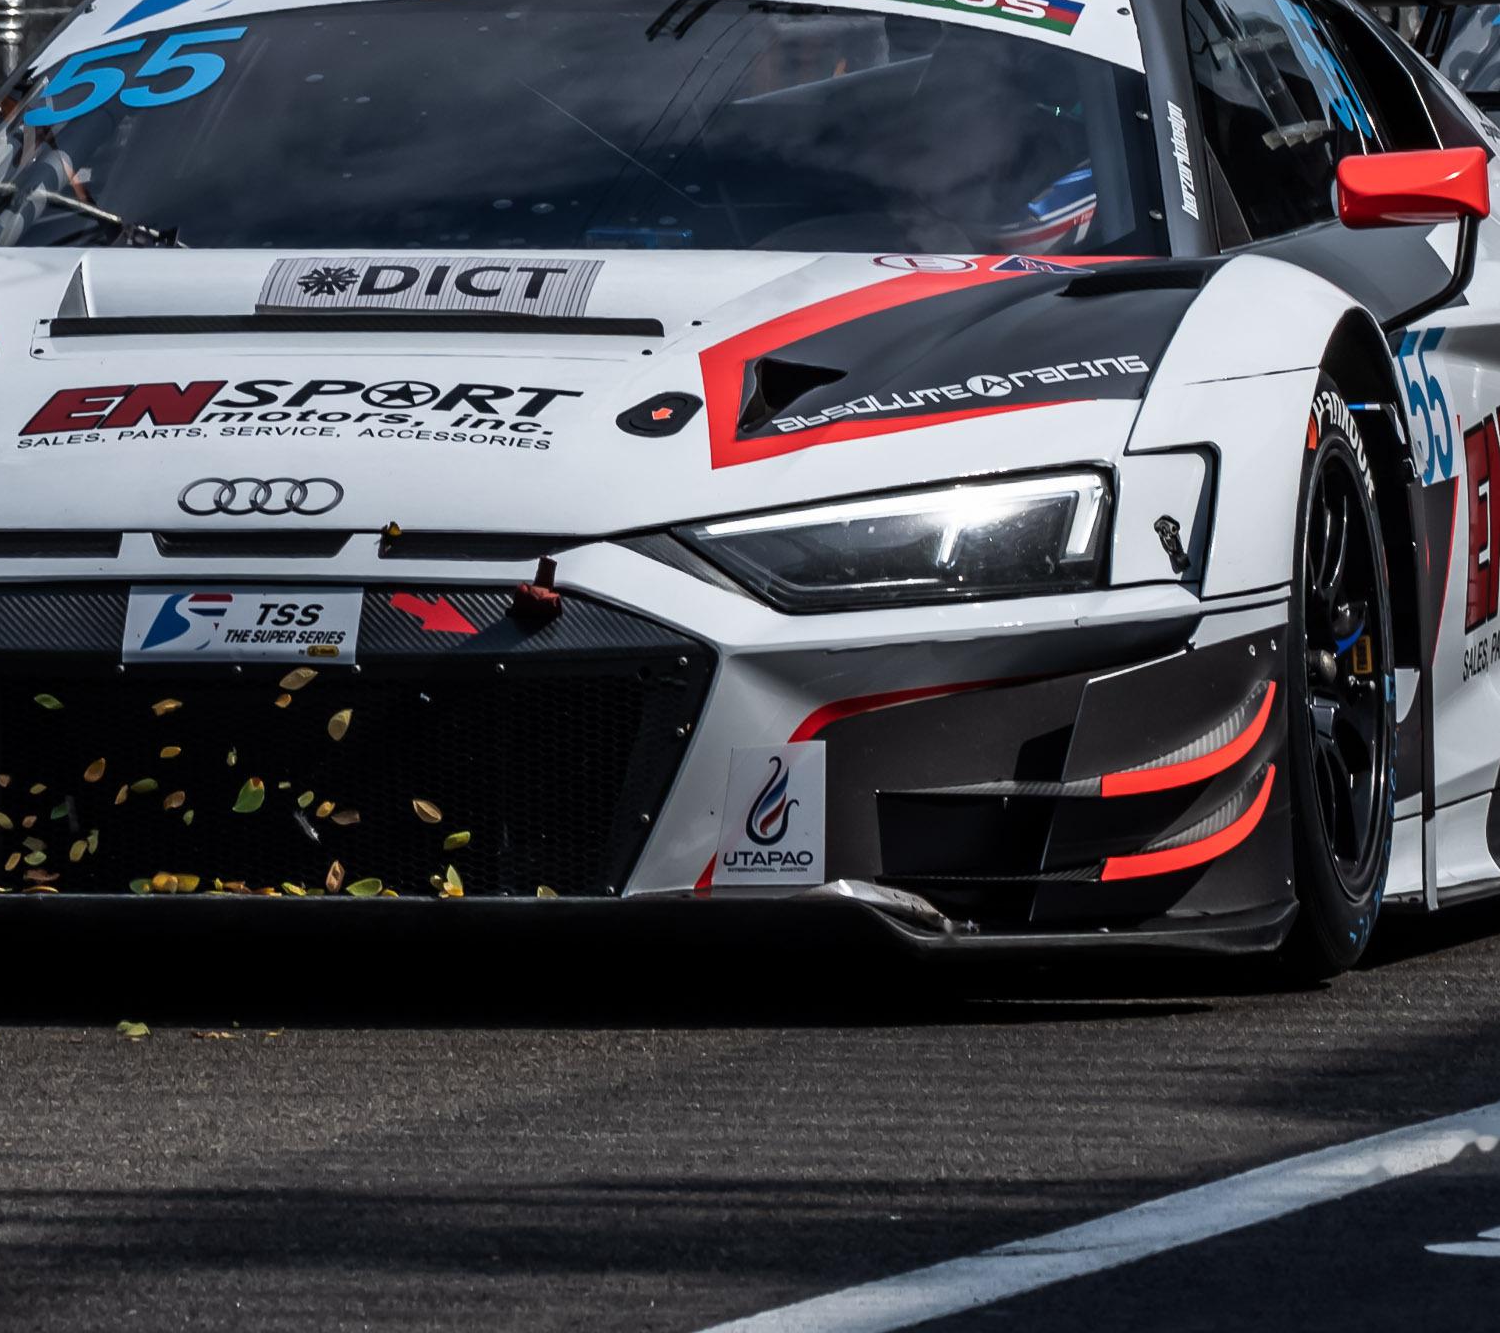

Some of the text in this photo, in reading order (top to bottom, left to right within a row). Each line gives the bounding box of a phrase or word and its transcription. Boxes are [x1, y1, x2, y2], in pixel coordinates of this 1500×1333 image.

[23, 26, 249, 127] 55
[357, 264, 569, 299] DICT
[201, 409, 555, 437] motors, inc.
[17, 425, 553, 452] SALES, PARTS, SERVICE, ACCESSORIES
[256, 603, 324, 627] TSS
[224, 629, 347, 644] THE SUPER SERIES
[723, 850, 814, 866] UTAPAO
